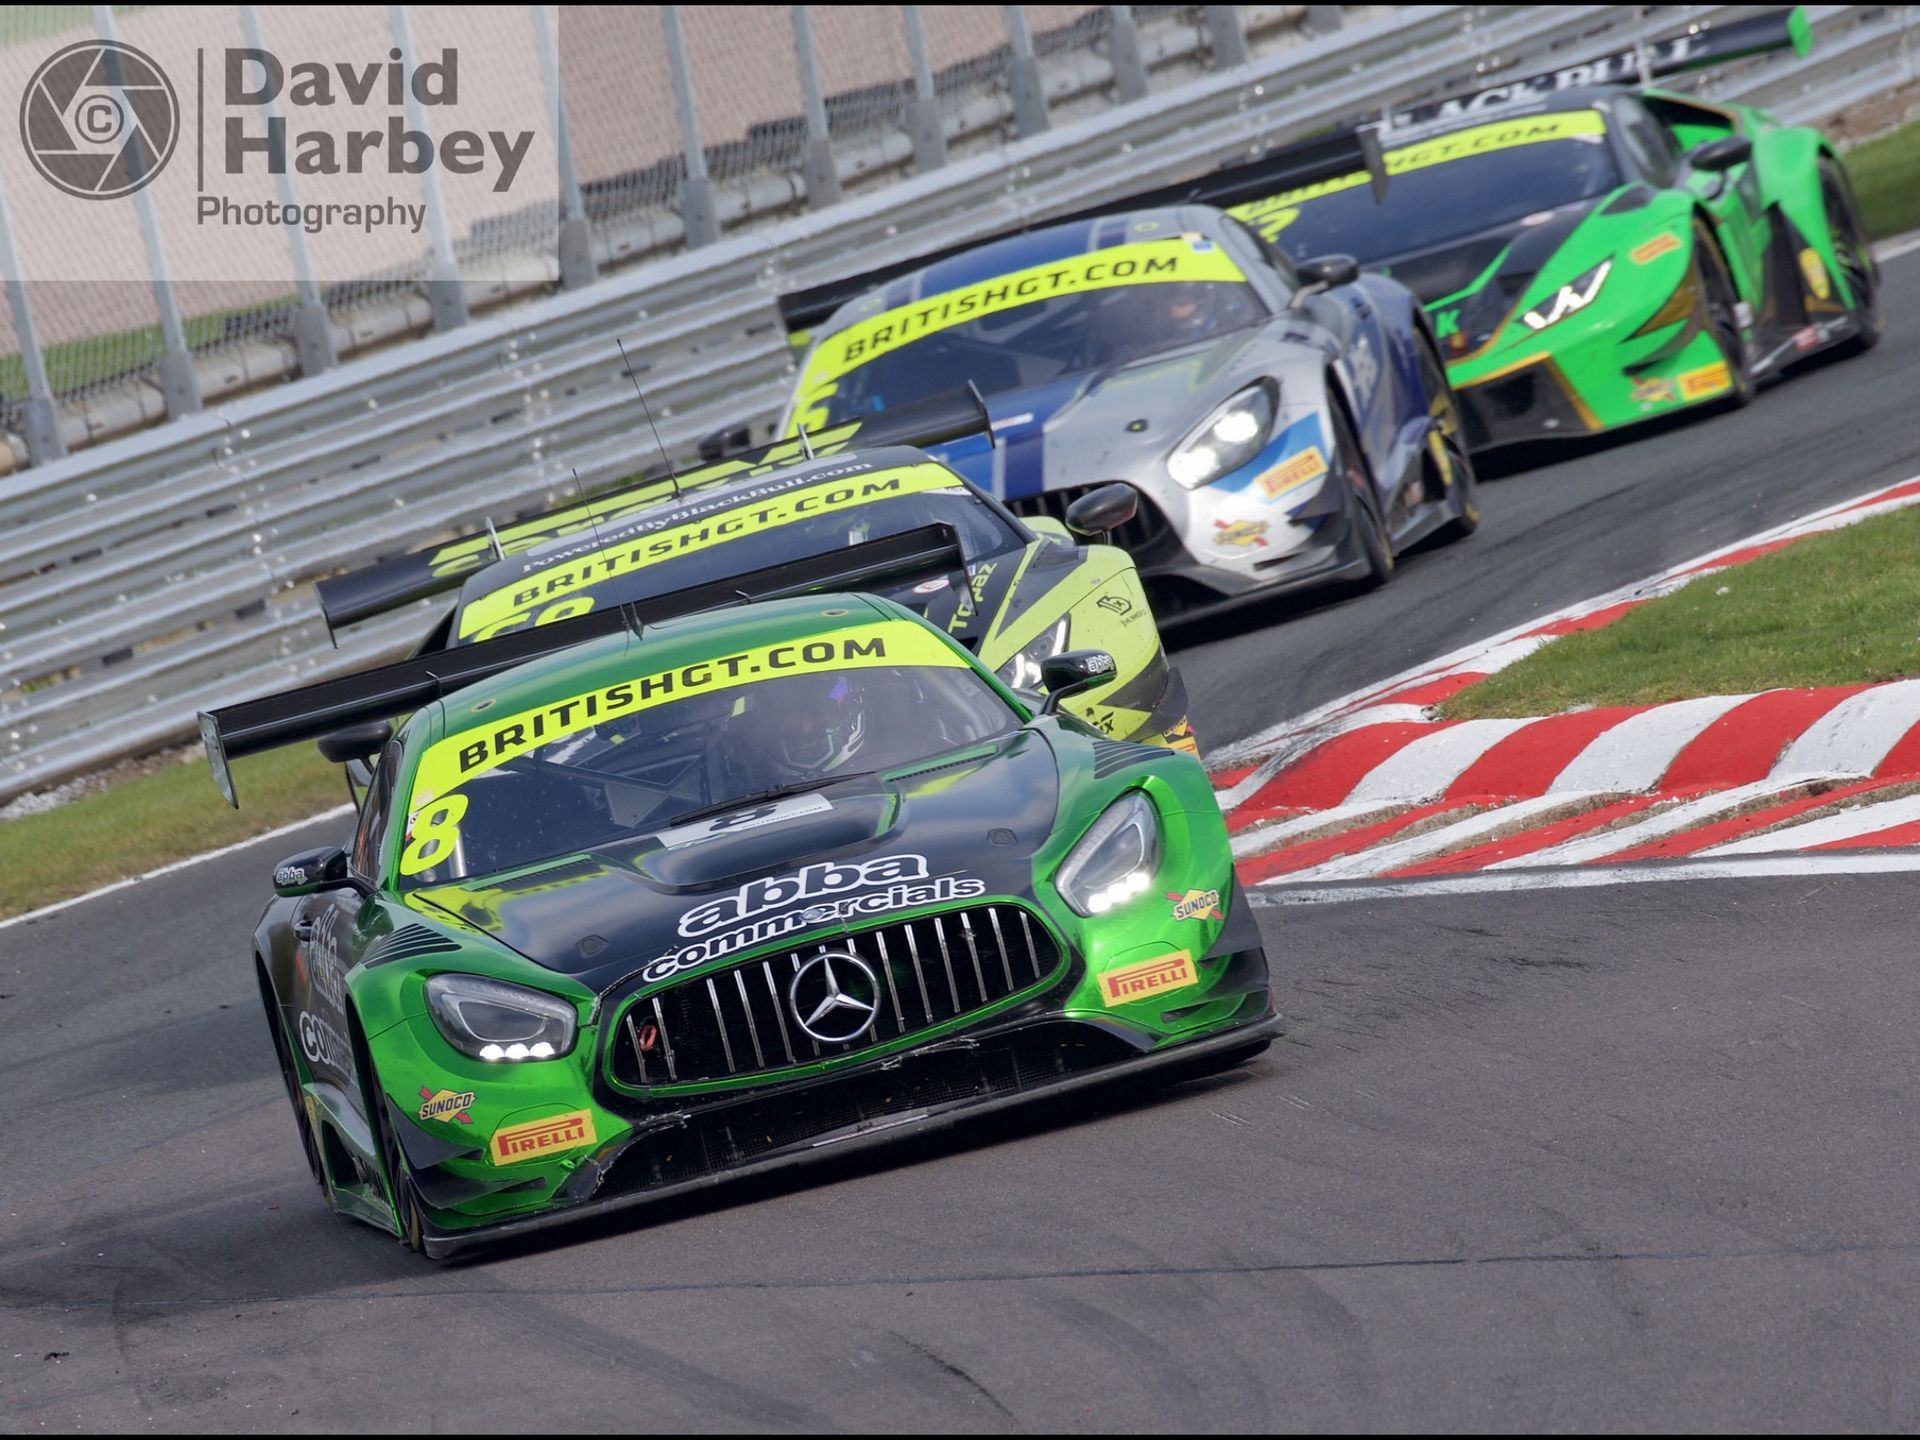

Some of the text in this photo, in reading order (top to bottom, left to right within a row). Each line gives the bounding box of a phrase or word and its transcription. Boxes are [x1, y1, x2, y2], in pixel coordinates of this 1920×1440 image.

[843, 256, 1179, 364] BRITISHGT.COM
[514, 479, 900, 607] BRITISHGT.COM
[459, 637, 886, 774] BRITISHGT.COM
[400, 793, 469, 876] 8
[642, 877, 986, 983] commercials
[677, 854, 930, 938] abba
[1175, 891, 1218, 919] SUNOCO
[1107, 958, 1188, 998] PIRELLI
[421, 1093, 473, 1118] SUNOCO
[497, 1117, 585, 1157] PIRELLI
